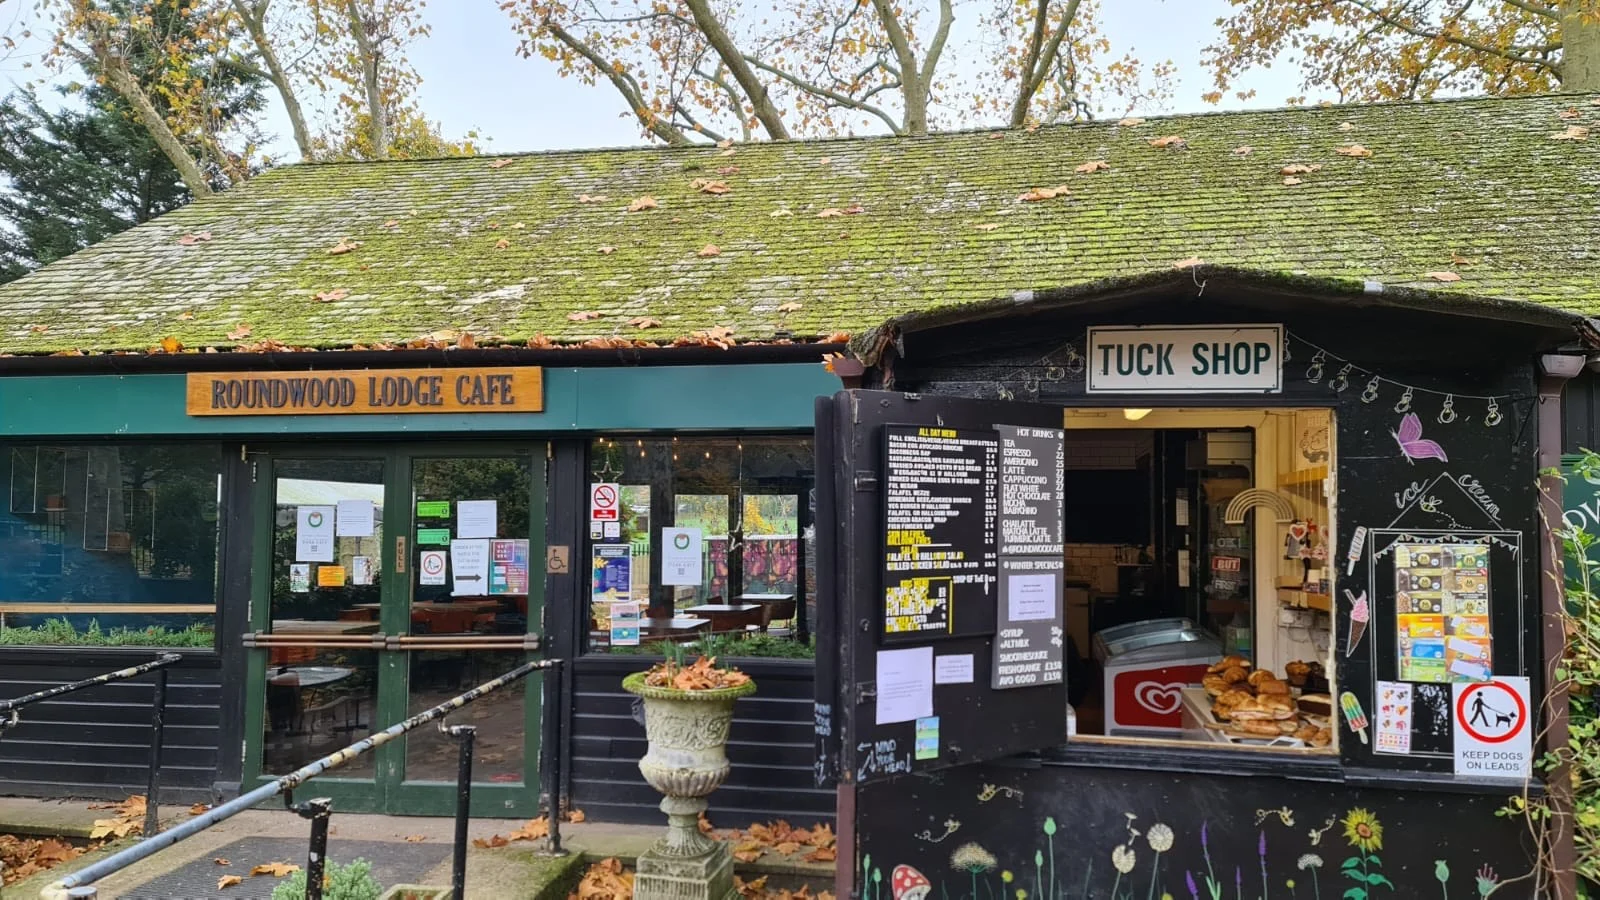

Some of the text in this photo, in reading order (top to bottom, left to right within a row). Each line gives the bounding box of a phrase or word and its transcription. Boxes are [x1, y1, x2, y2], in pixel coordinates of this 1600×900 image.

[1098, 342, 1271, 376] TUCK SHOP
[211, 374, 515, 409] ROUNDWOOD LODGE CAFE
[1017, 428, 1054, 438] HOT DRINKS
[1003, 439, 1015, 447] TEA
[1003, 448, 1031, 457] ESPRESSO
[1003, 457, 1038, 466] AMERICANO
[1003, 466, 1025, 474] LATTE
[1003, 475, 1047, 484] CAPPUCCINO
[1003, 484, 1018, 492] FLAT
[1003, 491, 1016, 500] HOT
[1017, 492, 1051, 500] CHOCOLATE
[1394, 478, 1429, 509] ice
[1003, 499, 1025, 507] MOCHA
[1029, 528, 1047, 536] LATTE
[1004, 535, 1032, 543] TURMERIC
[1010, 561, 1058, 569] WINTER SPECIALS
[1218, 559, 1237, 569] BUT
[1215, 580, 1236, 590] FIRST
[814, 702, 831, 714] MIND
[815, 726, 831, 736] HEAD
[875, 739, 896, 752] MIND
[1462, 751, 1523, 760] KEEP DOGS
[884, 760, 905, 773] HEAD
[1466, 761, 1520, 771] ON LEADS
